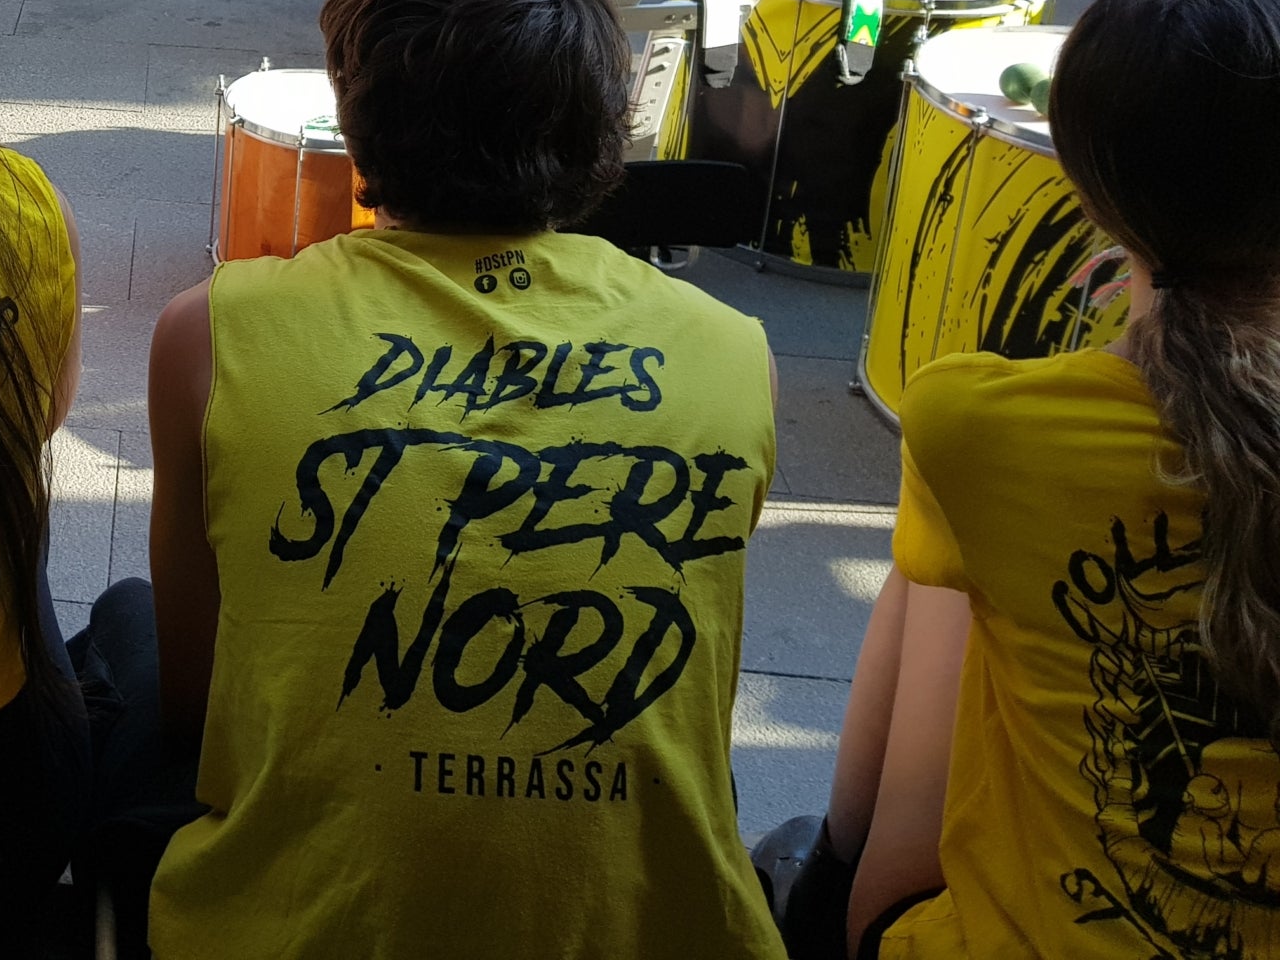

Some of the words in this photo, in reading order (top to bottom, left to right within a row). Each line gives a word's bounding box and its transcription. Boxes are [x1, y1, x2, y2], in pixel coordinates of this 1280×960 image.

[474, 249, 526, 275] #DStPN
[318, 332, 666, 423] DIABLES
[429, 433, 752, 585] PERE
[336, 552, 697, 757] NORD
[409, 751, 630, 803] TERRASSA
